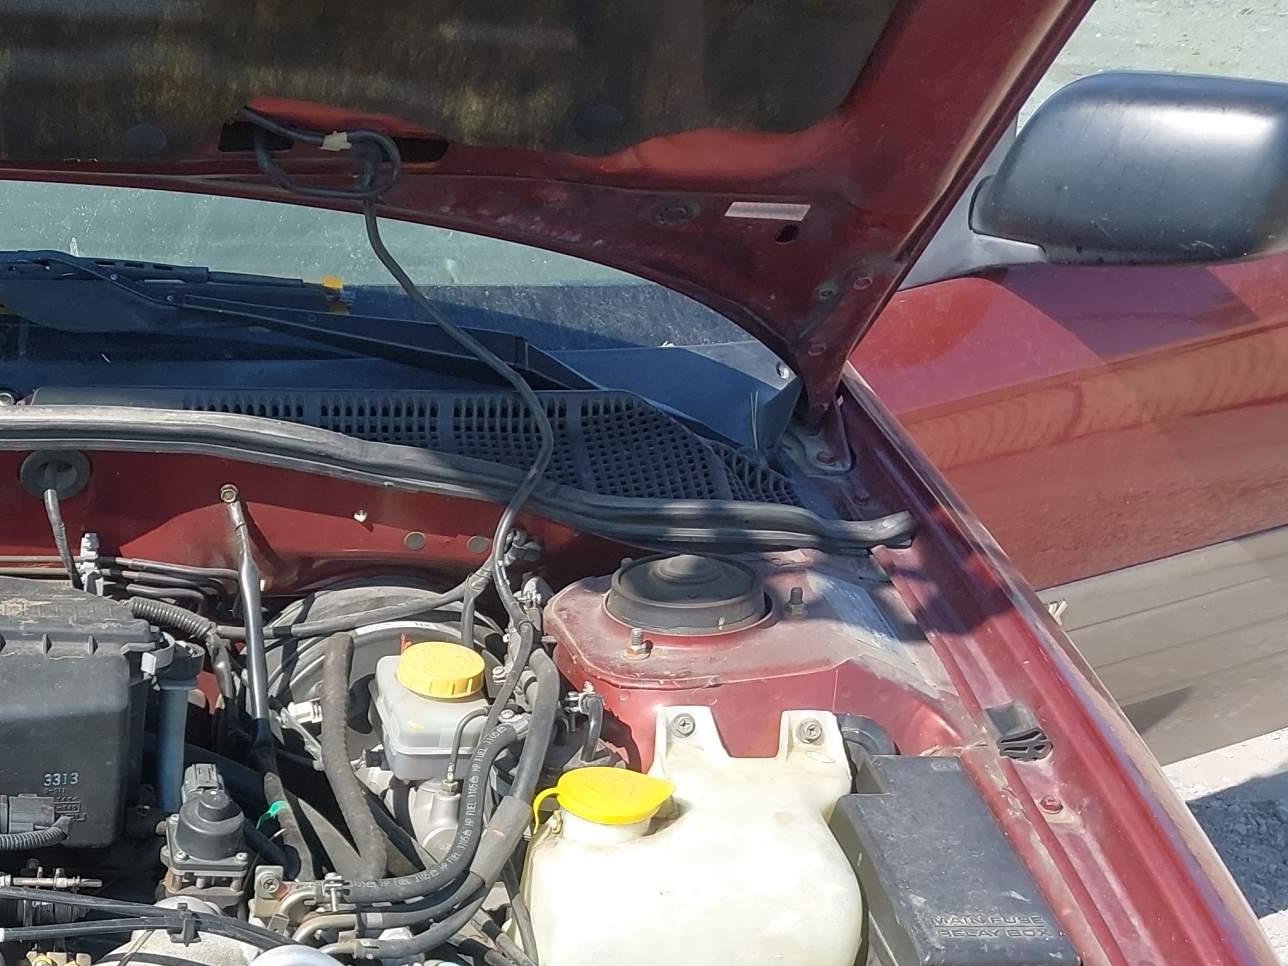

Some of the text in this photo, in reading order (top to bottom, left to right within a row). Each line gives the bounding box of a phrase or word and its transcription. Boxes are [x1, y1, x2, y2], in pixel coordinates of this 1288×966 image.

[43, 772, 79, 786] 3313
[931, 914, 1044, 925] MAIN FUSE
[937, 929, 1052, 937] RELAY BOX
